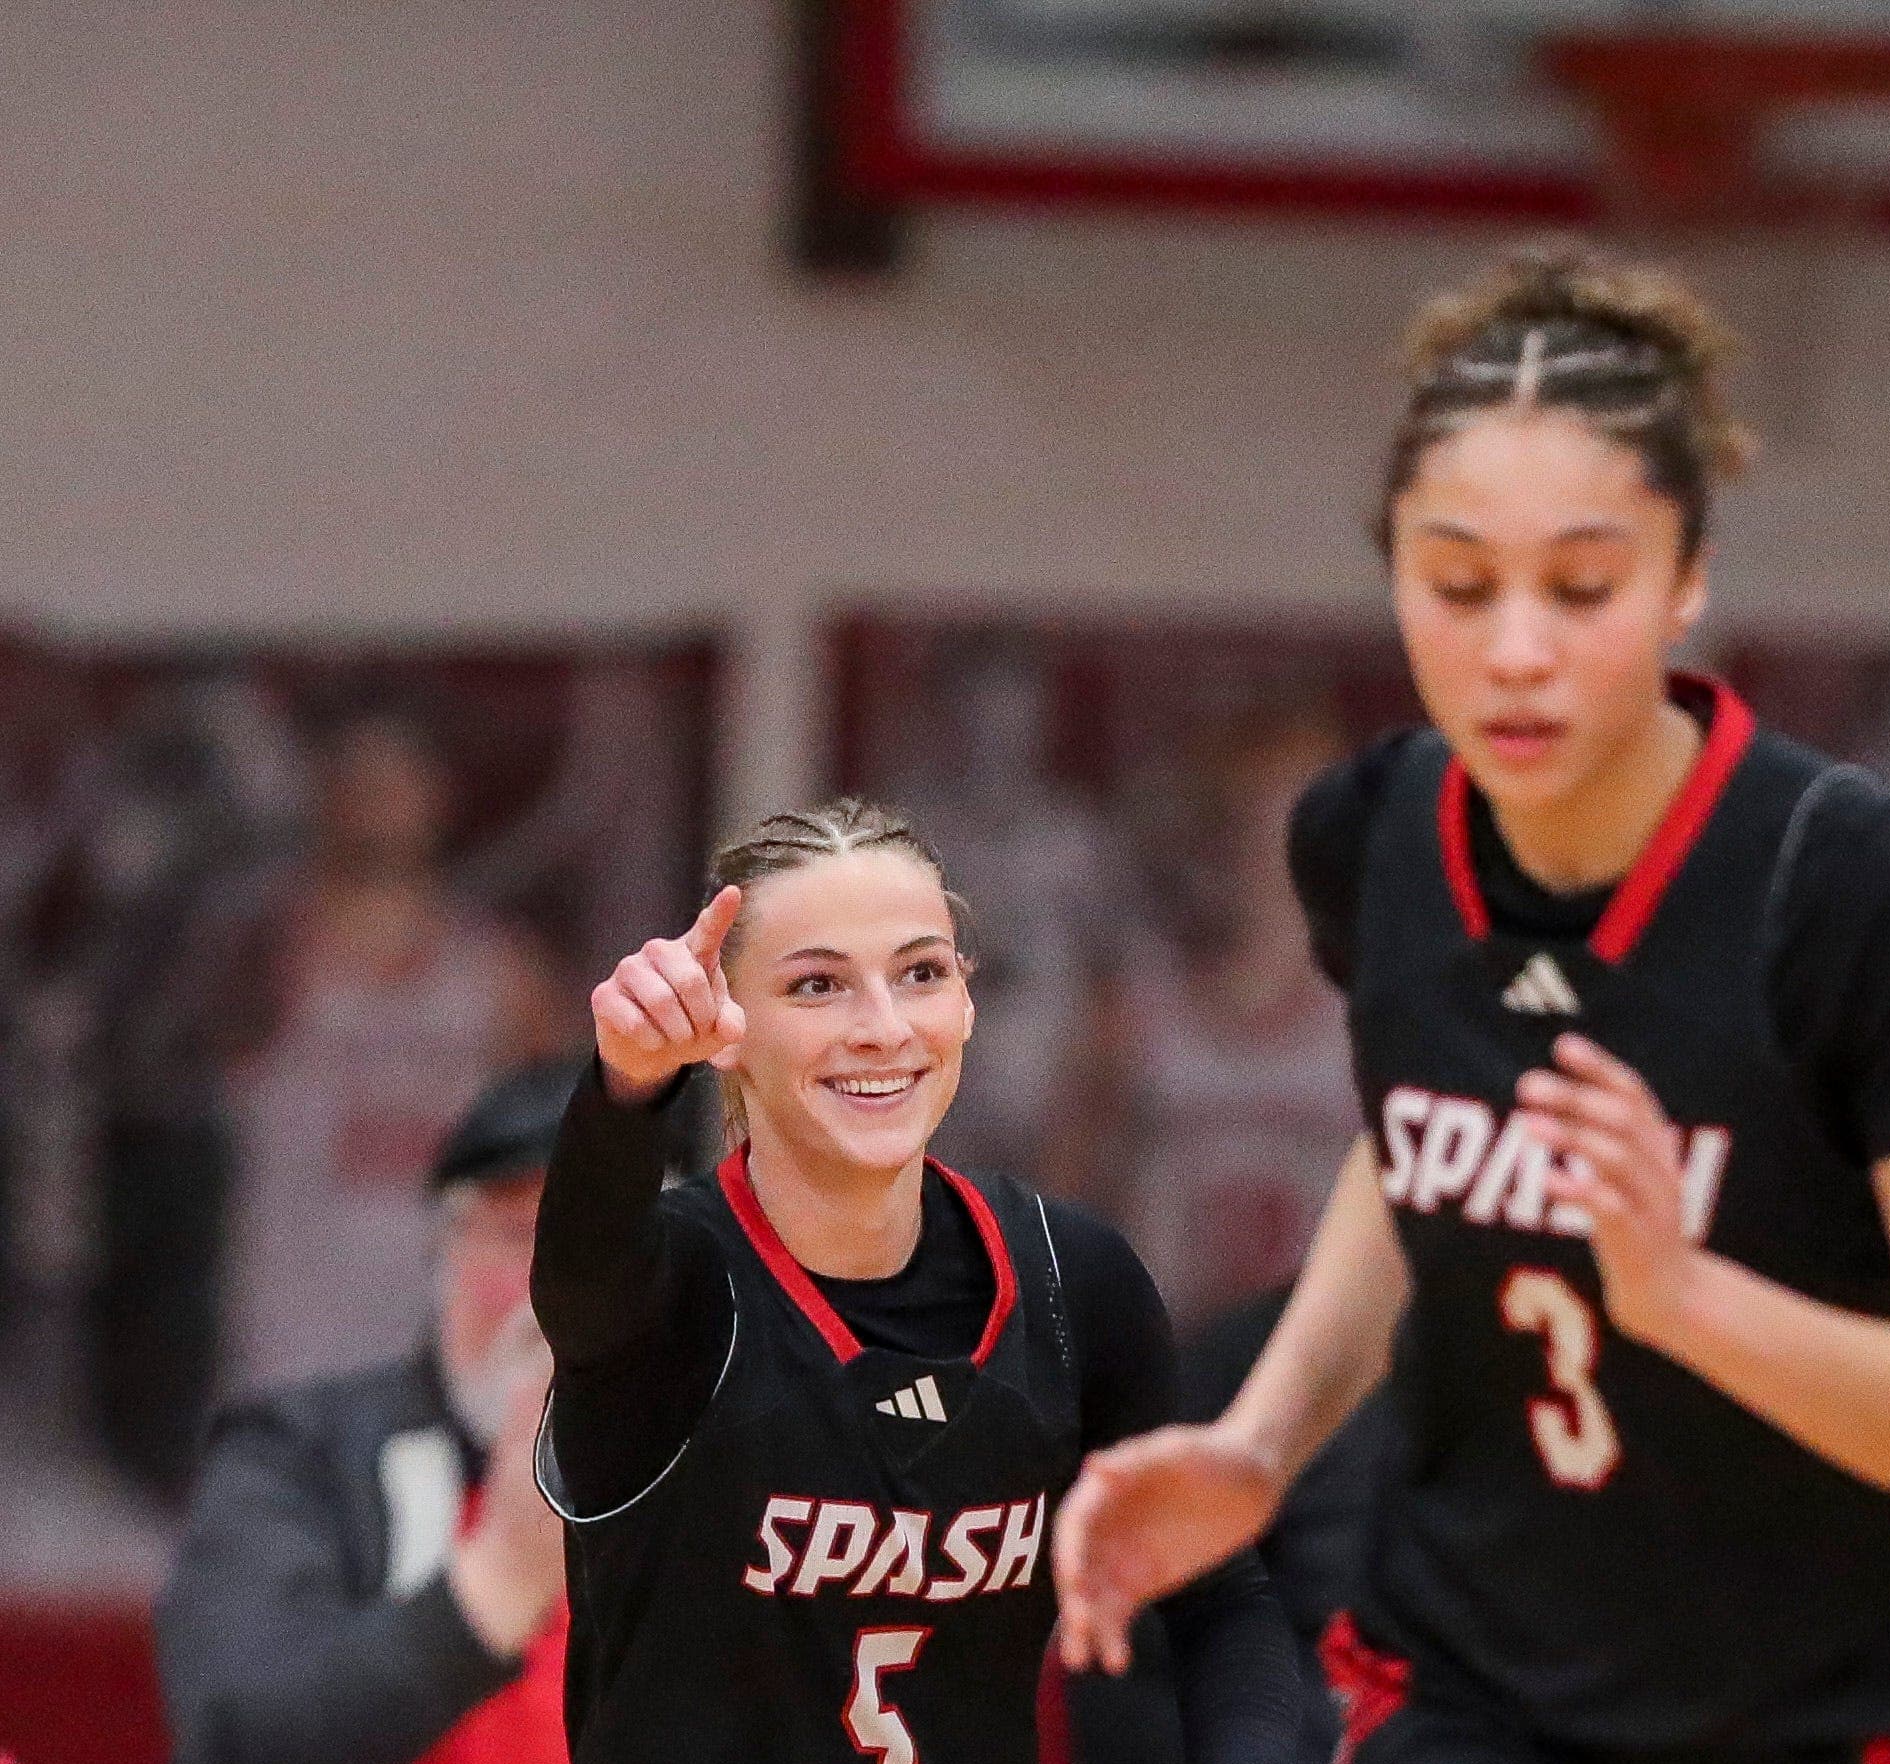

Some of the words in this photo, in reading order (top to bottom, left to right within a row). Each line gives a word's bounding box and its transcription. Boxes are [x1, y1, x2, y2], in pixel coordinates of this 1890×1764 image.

[1380, 1085, 1732, 1247] SPA
[1497, 1264, 1624, 1491] 3
[741, 1491, 1046, 1602] SPASH
